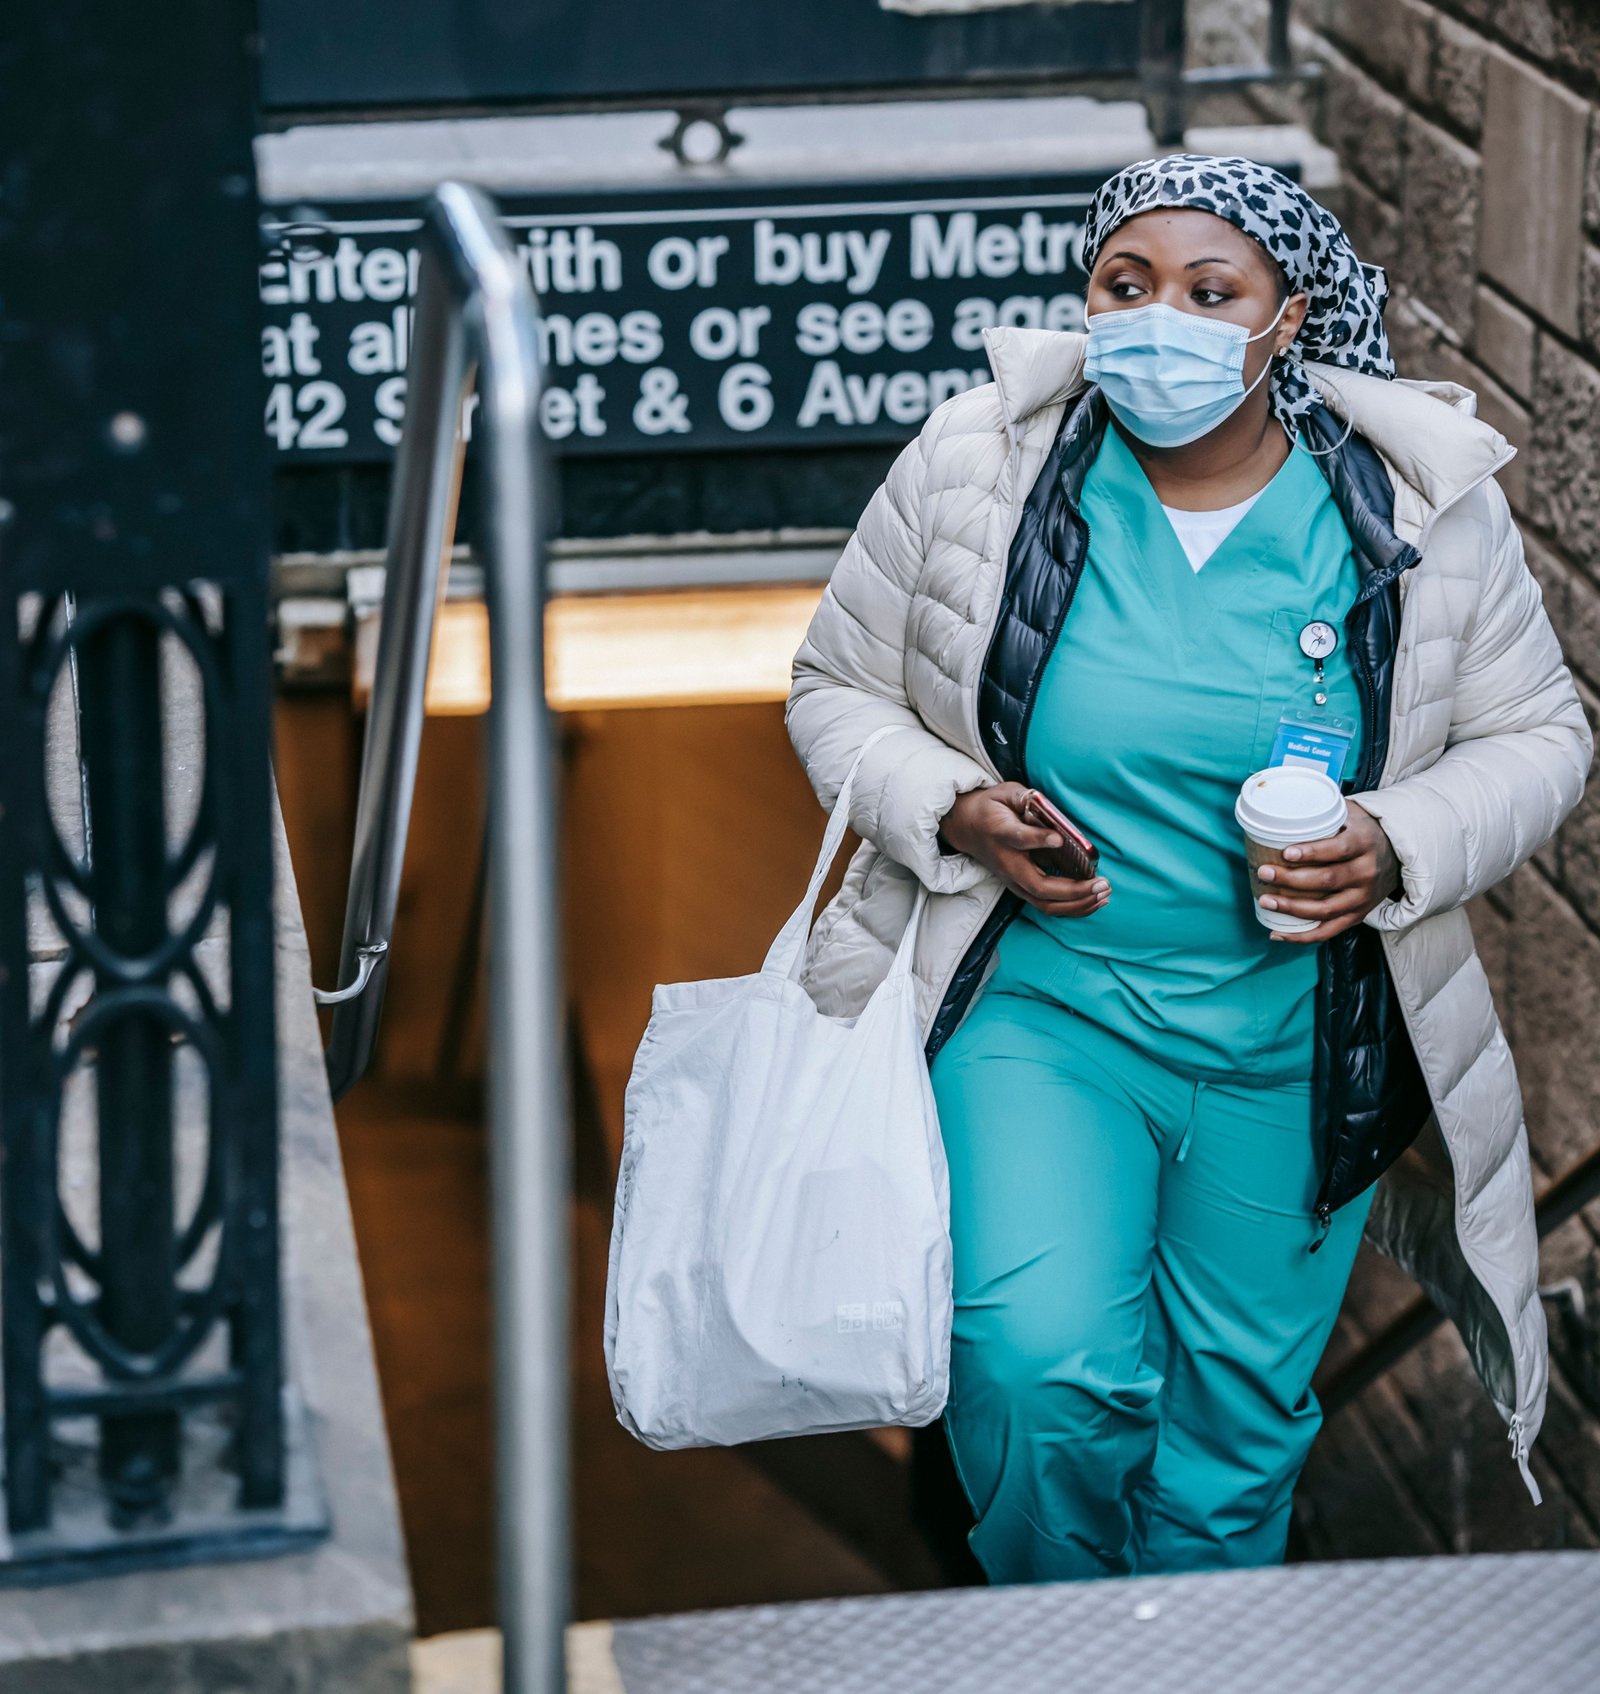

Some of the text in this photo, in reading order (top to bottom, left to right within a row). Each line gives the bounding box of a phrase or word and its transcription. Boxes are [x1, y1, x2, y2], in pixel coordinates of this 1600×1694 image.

[518, 227, 621, 293] ith
[648, 236, 729, 290] or
[753, 219, 891, 294] buy
[261, 312, 321, 377] at
[347, 305, 416, 373] al
[690, 305, 771, 360] or
[797, 299, 934, 355] see
[264, 381, 348, 449] 42
[633, 366, 692, 436] &
[719, 361, 774, 432] 6
[797, 361, 988, 428] Aven
